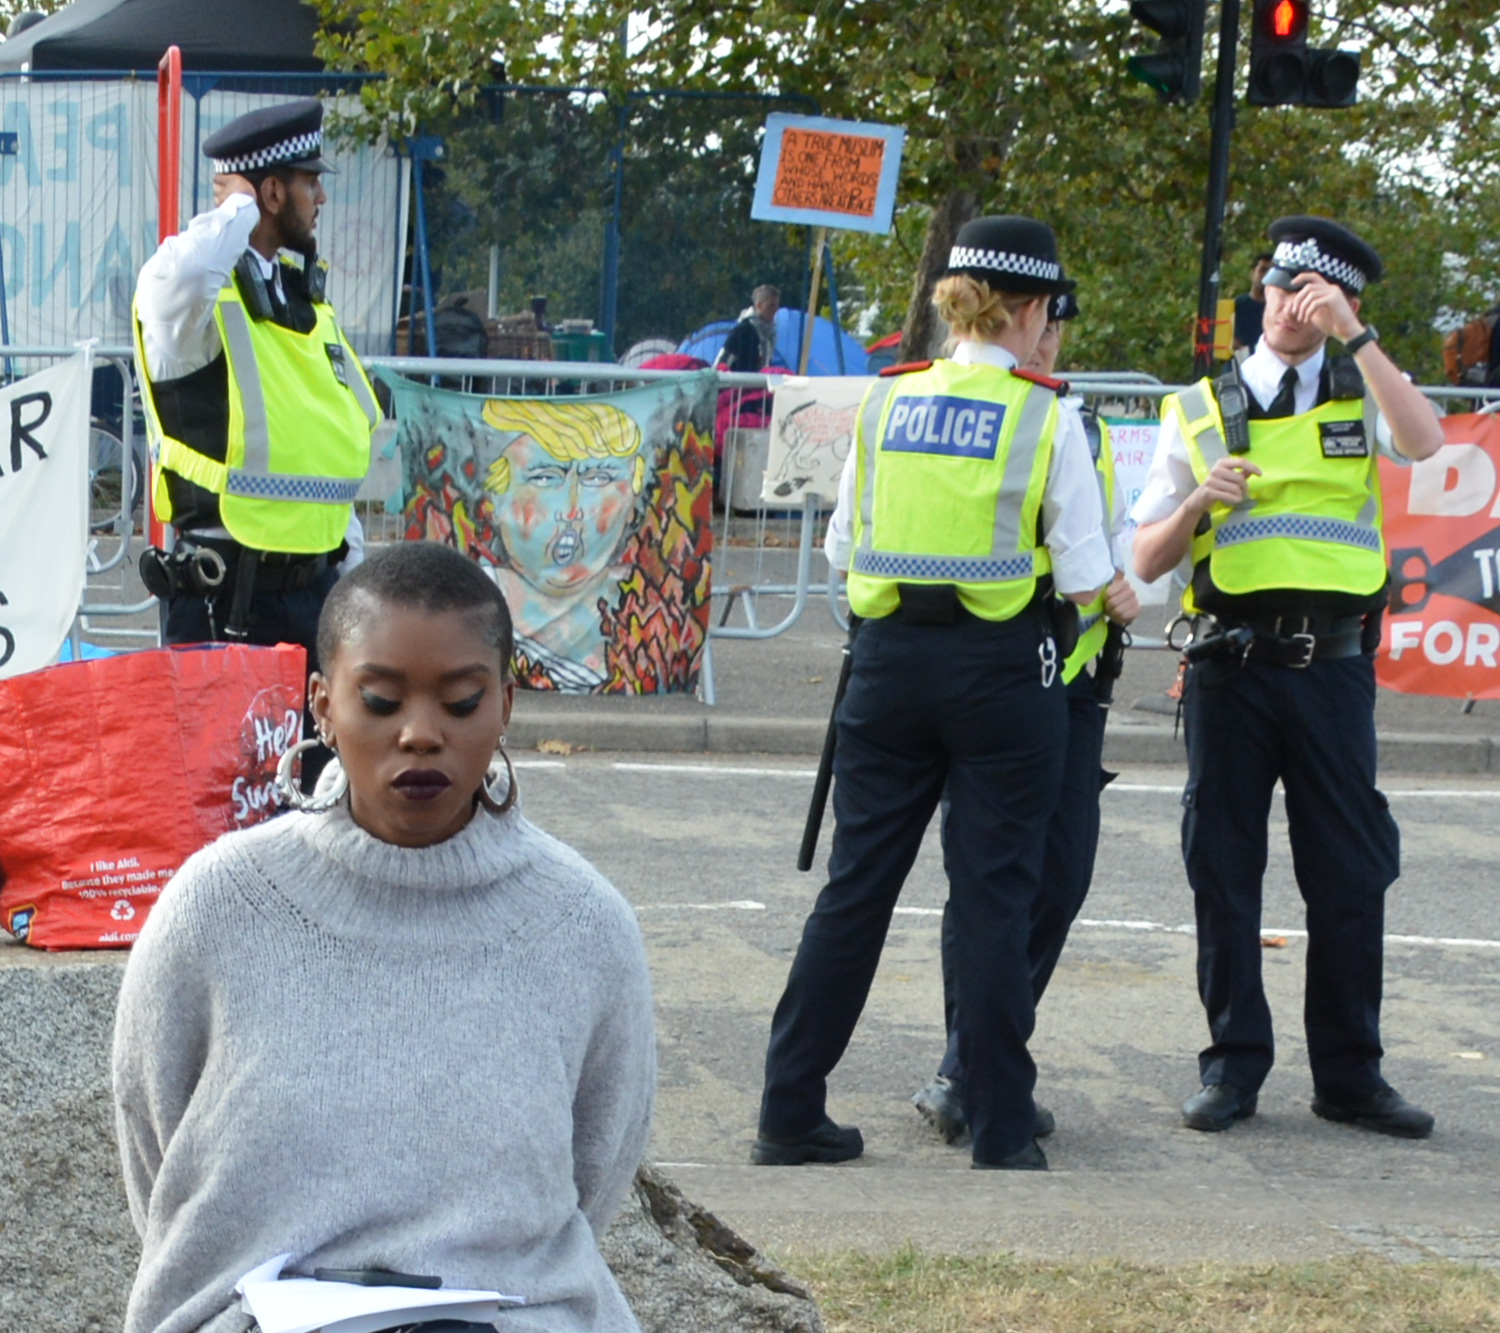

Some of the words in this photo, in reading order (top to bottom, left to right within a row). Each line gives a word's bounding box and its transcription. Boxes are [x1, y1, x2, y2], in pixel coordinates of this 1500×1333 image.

[787, 132, 797, 147] A
[803, 133, 836, 151] TRUE
[838, 136, 885, 159] MUSLIM
[798, 151, 820, 166] ONE
[823, 154, 861, 172] FROM
[832, 170, 879, 187] WORDS
[886, 404, 998, 449] POLICE
[1113, 450, 1145, 466] AIR
[1389, 620, 1500, 668] FOR
[96, 860, 115, 872] like
[102, 874, 125, 886] they
[126, 869, 156, 881] made
[158, 869, 175, 877] me
